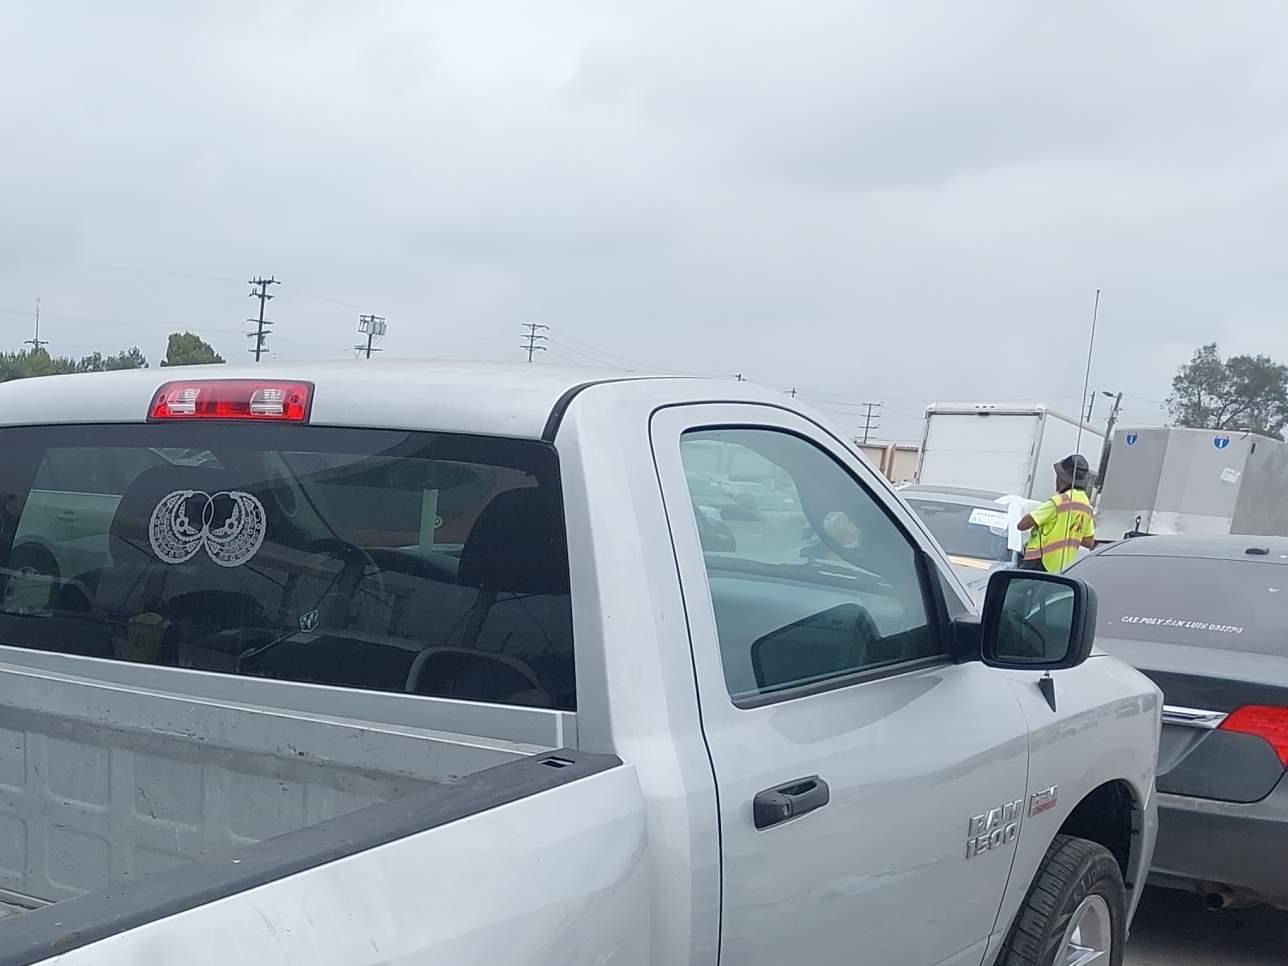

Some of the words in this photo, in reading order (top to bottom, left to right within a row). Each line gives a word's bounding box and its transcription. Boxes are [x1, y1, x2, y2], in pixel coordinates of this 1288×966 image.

[1139, 616, 1163, 625] POLY
[1163, 617, 1185, 628] SAN
[1185, 619, 1209, 629] LUIS
[965, 822, 1017, 860] 1500
